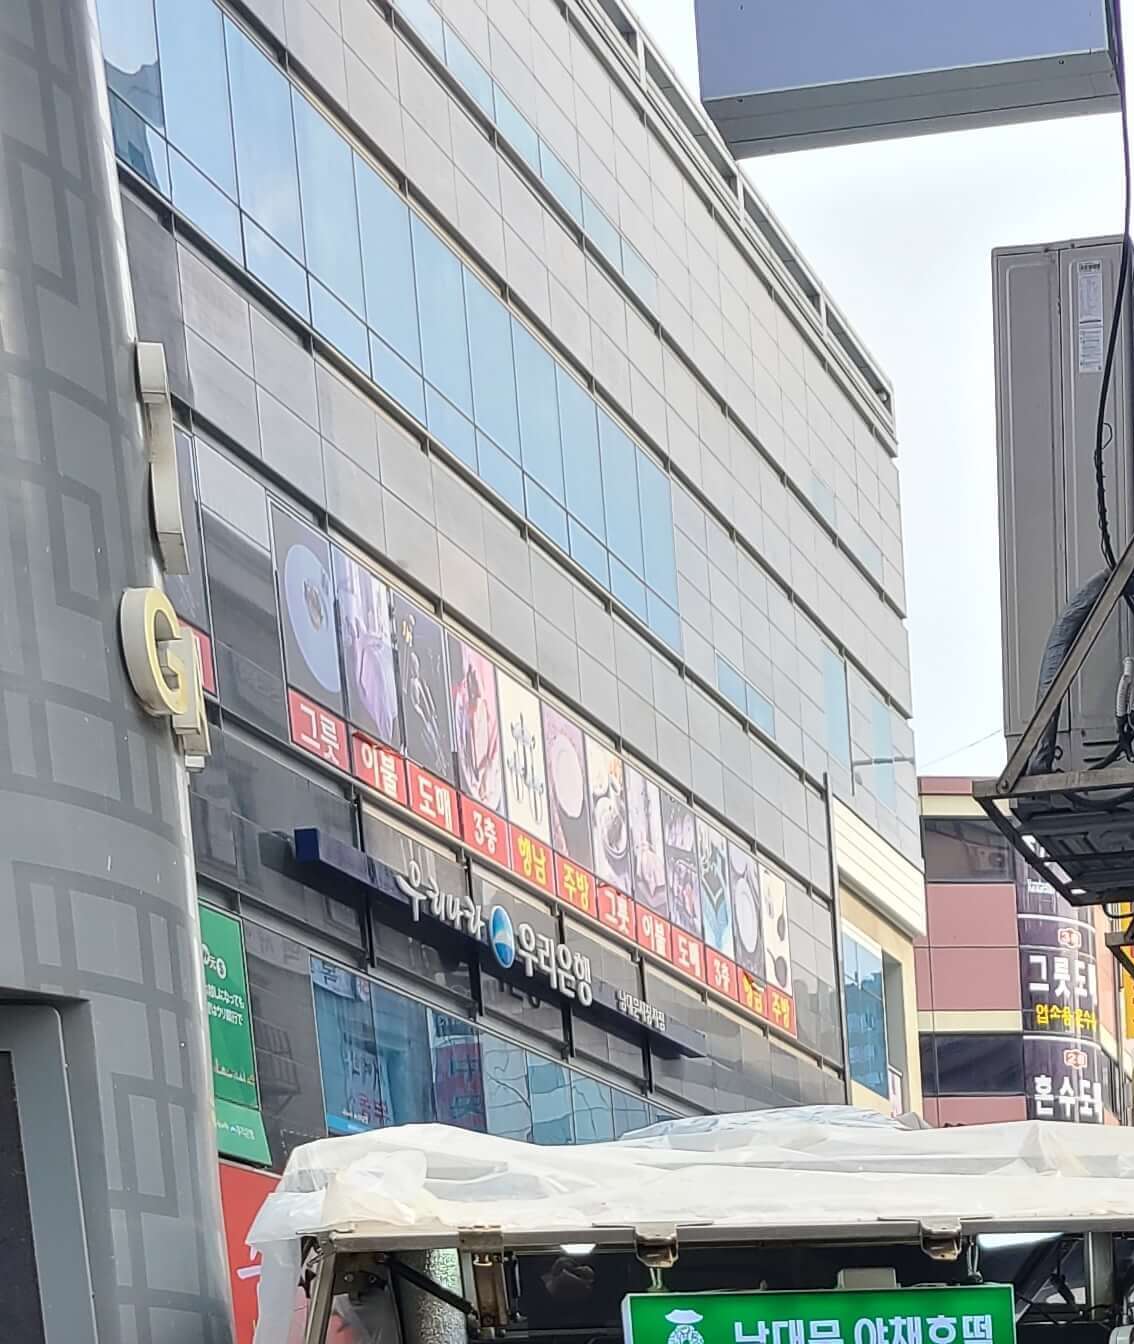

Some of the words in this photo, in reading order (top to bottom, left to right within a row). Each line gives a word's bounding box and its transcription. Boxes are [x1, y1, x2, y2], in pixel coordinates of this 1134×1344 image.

[300, 703, 339, 767] 그릇
[361, 743, 399, 800] 이불
[417, 774, 454, 833] 도매
[472, 812, 499, 855] 3층
[563, 864, 591, 913] 주방
[604, 890, 631, 936] 그릇
[641, 915, 667, 958] 이불
[677, 938, 702, 978] 도매
[771, 990, 790, 1030] 주방
[516, 922, 593, 1008] 우리은행
